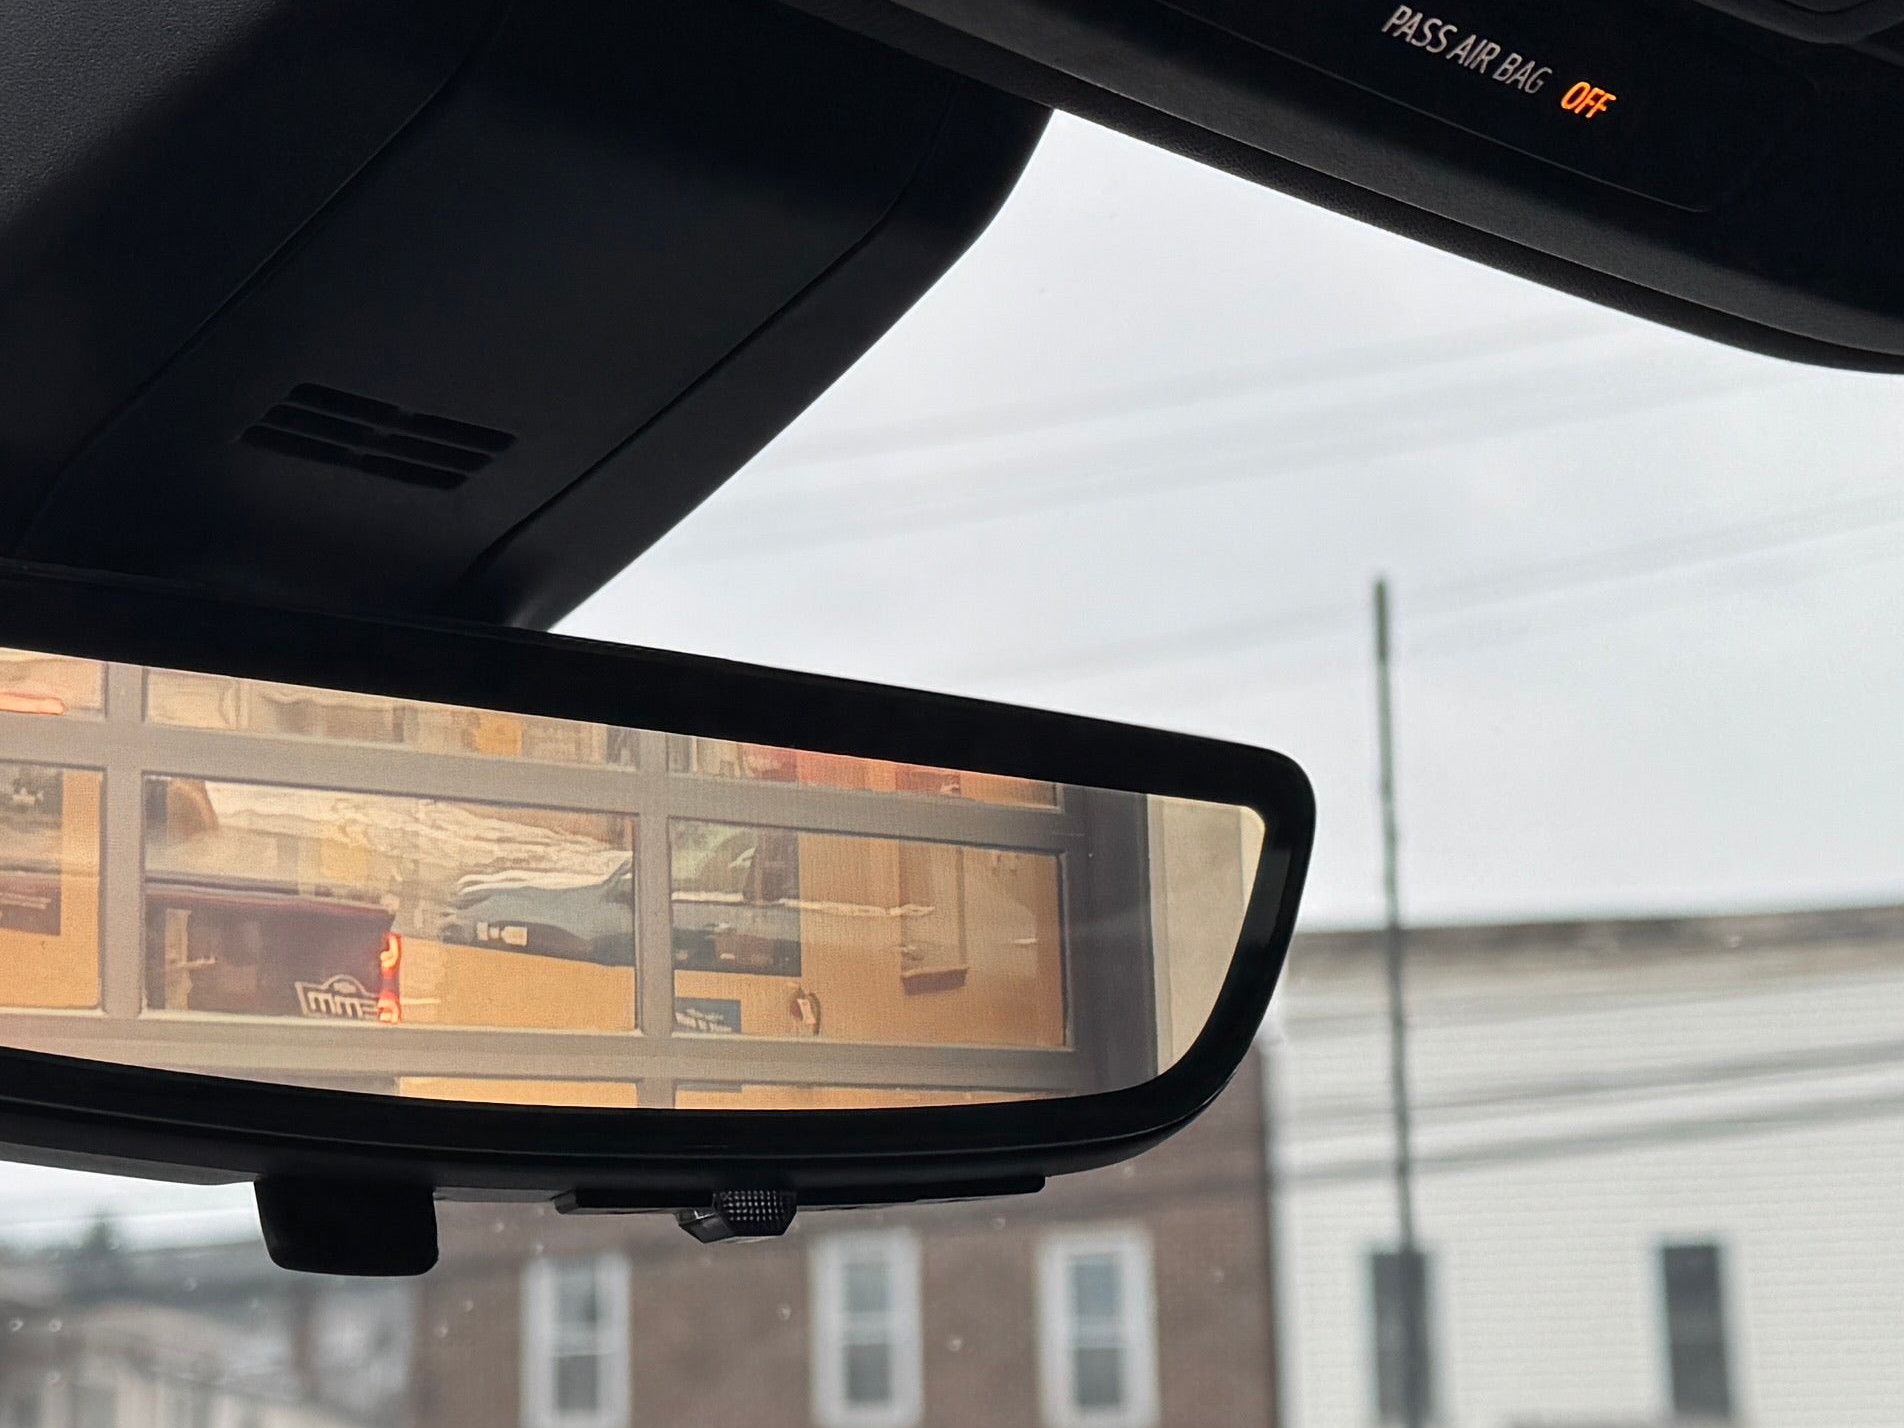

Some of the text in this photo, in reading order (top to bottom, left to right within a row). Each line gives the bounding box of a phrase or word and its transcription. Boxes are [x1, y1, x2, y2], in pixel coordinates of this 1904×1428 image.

[1381, 4, 1617, 119] PASS AIR BAG OFF
